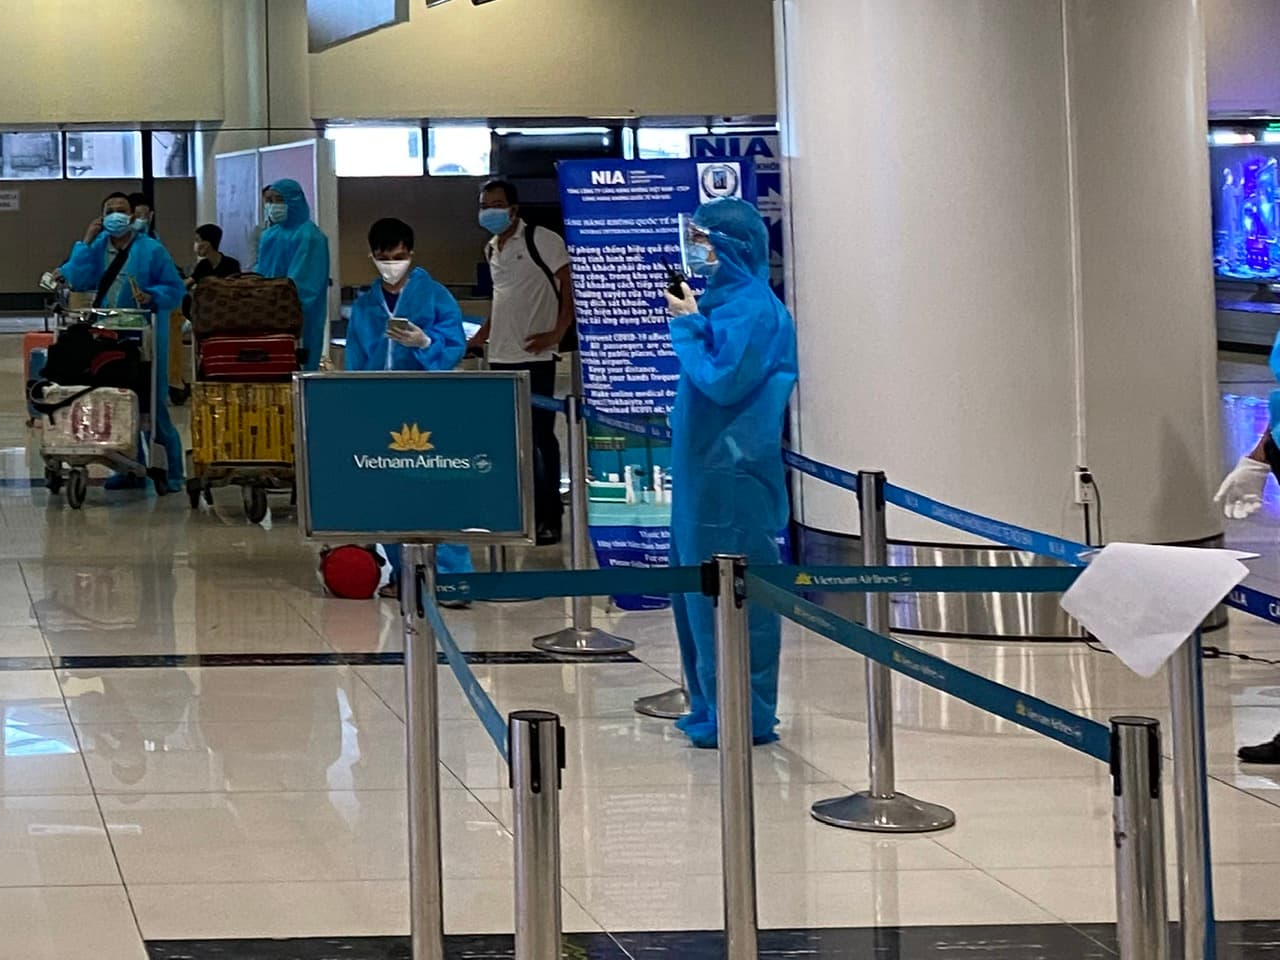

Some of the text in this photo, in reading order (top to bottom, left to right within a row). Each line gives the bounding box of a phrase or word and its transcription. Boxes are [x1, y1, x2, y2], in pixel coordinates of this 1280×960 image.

[695, 137, 774, 158] NIA
[591, 170, 625, 185] NIA
[353, 455, 470, 469] Vietnam Airlines
